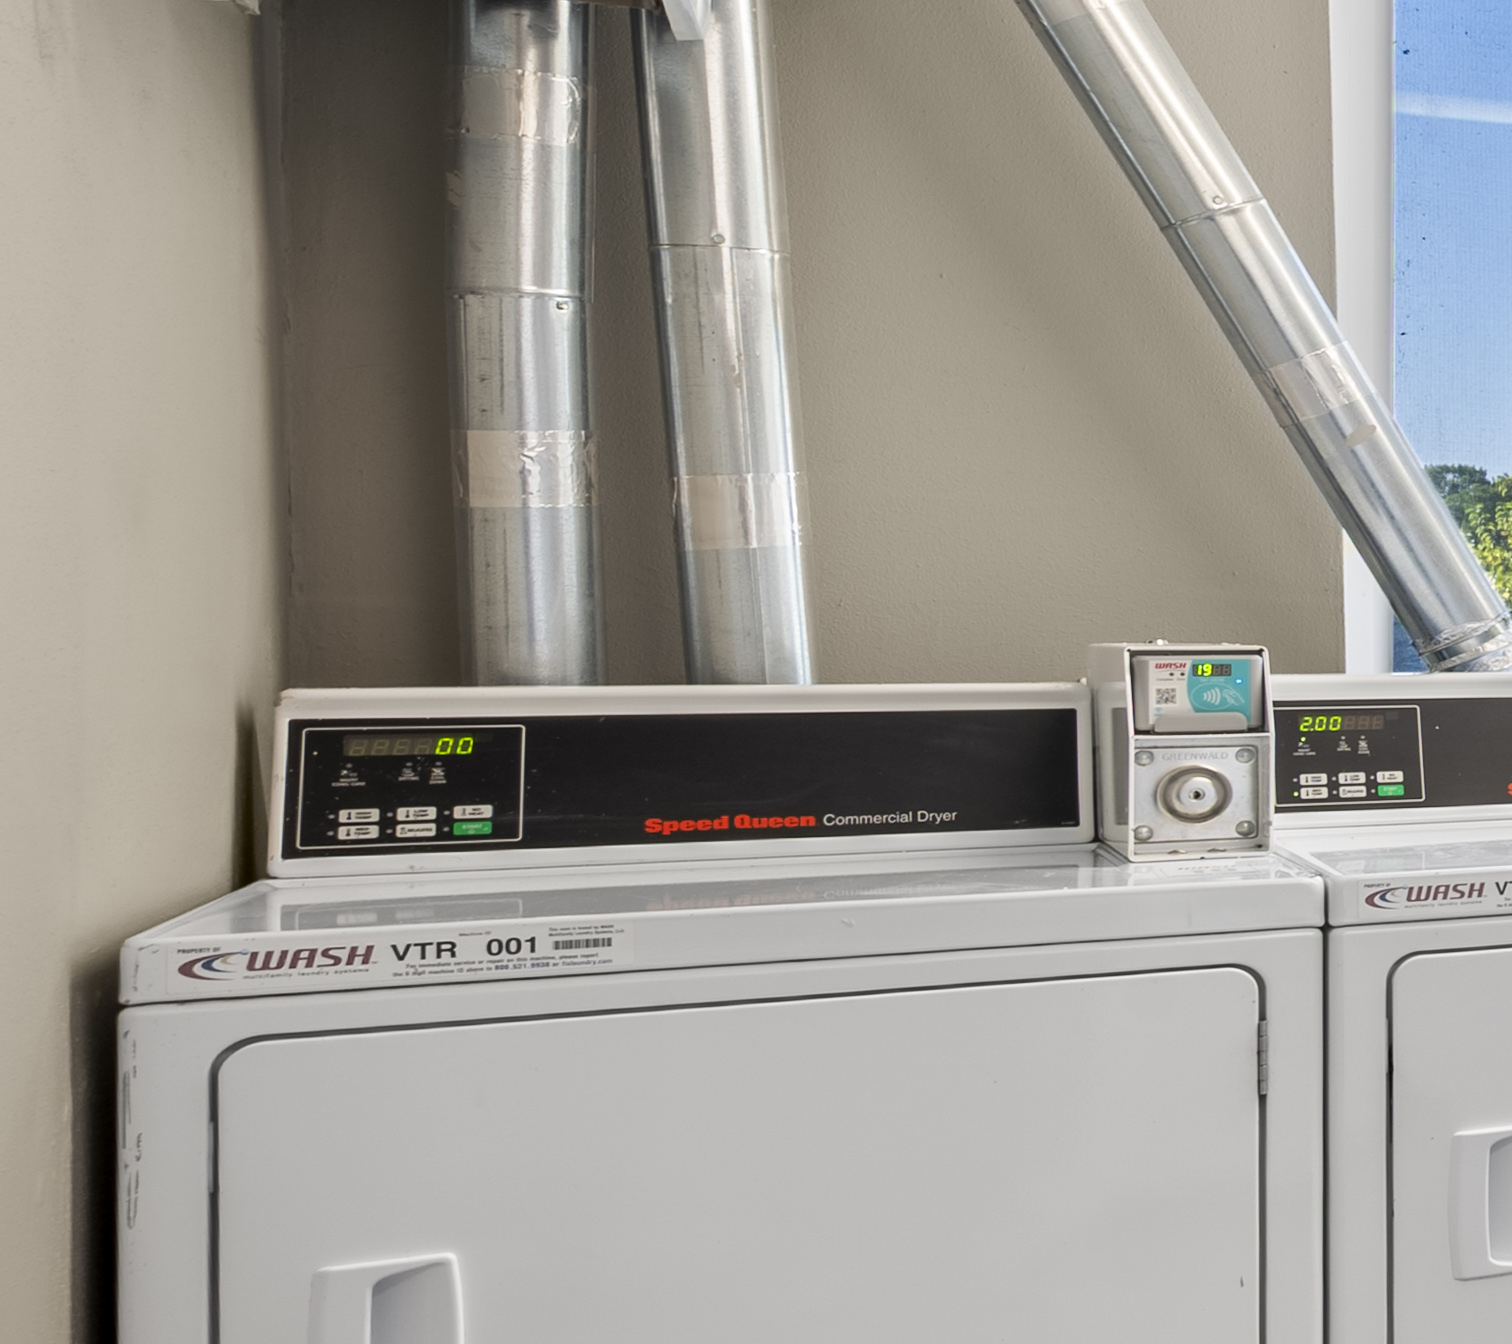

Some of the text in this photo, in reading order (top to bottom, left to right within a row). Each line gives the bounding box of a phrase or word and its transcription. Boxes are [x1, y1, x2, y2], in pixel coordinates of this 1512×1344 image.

[1300, 716, 1341, 732] 2.00
[1162, 751, 1228, 761] GREENWALD
[644, 810, 958, 835] Speed Queen Commercial Dryer
[1406, 882, 1485, 902] WASH
[246, 936, 537, 971] WASH VTR 001
[297, 970, 329, 978] laundry
